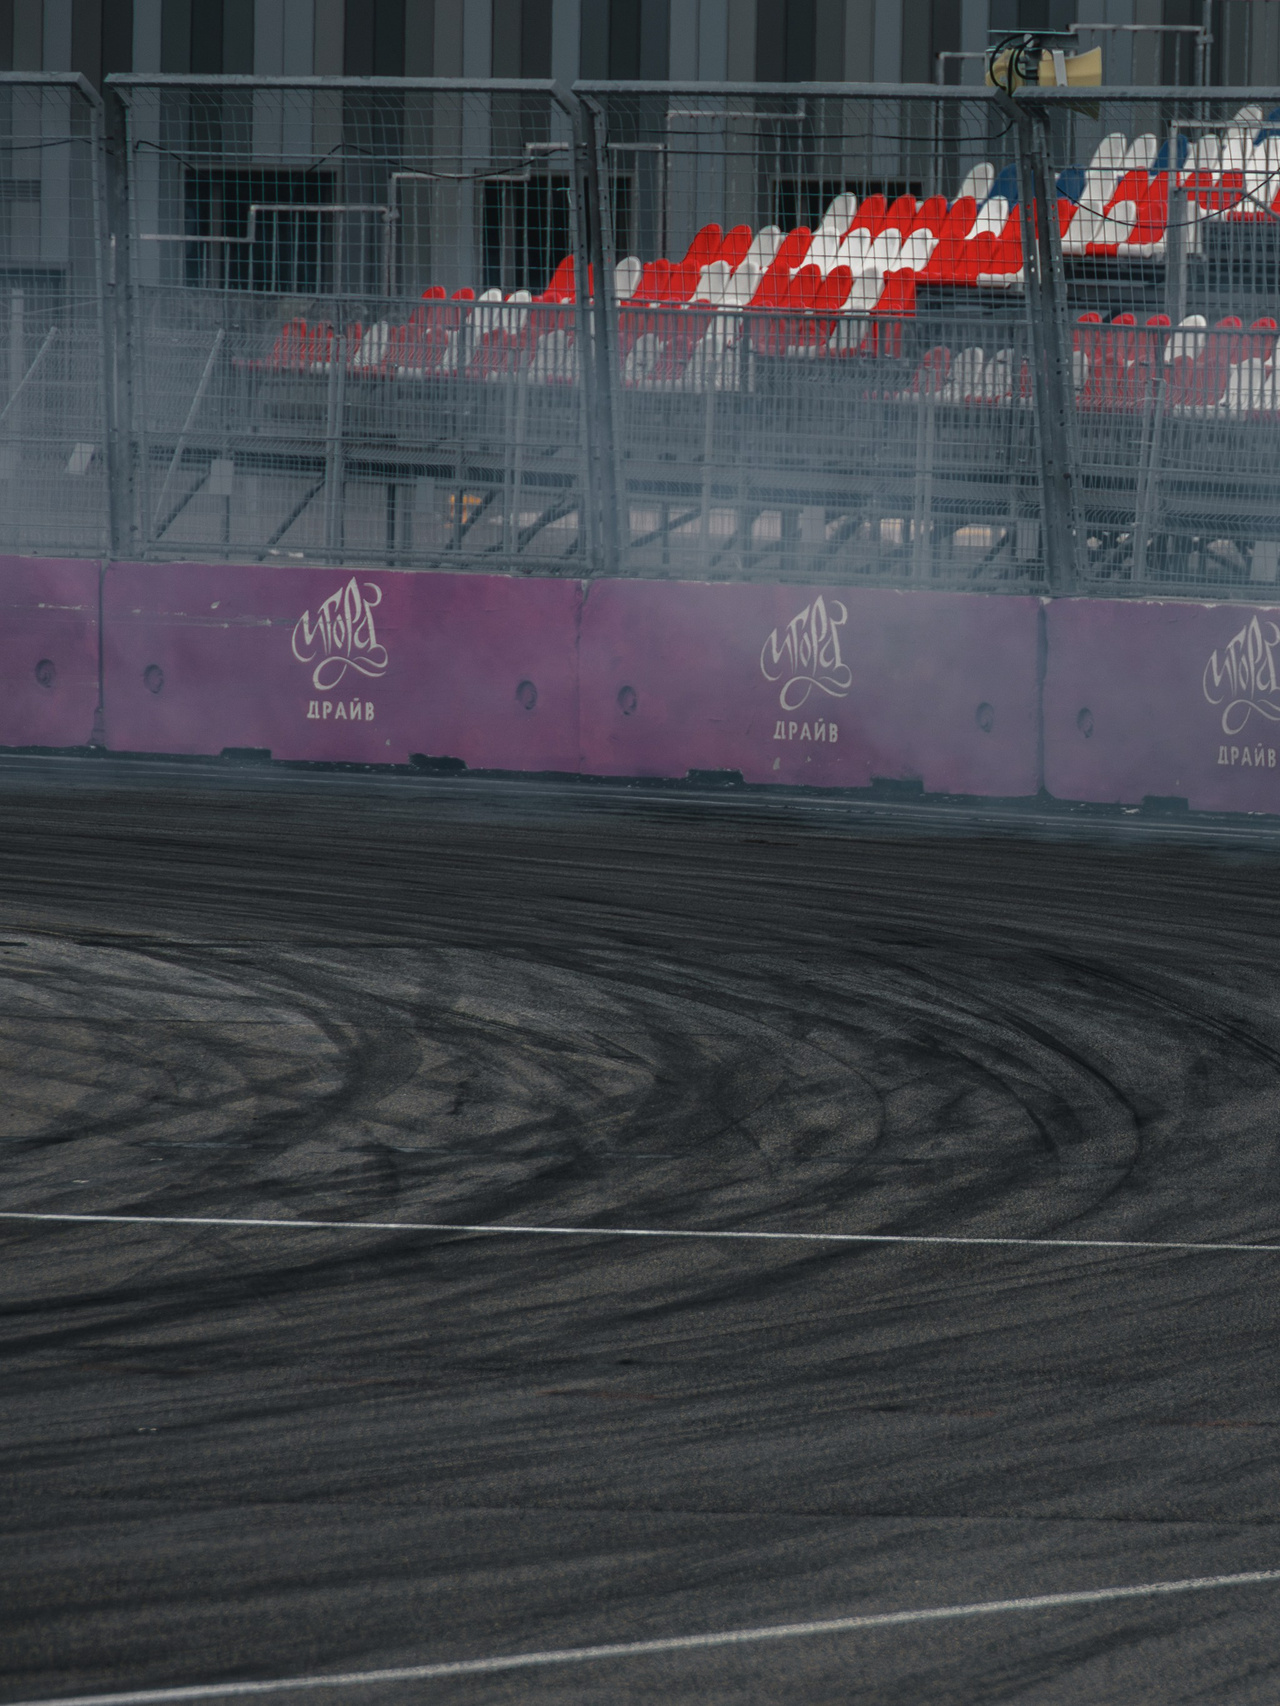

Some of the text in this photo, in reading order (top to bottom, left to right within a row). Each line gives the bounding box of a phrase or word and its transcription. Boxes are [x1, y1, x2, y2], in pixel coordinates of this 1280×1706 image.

[306, 697, 375, 721] ДРАЙВ
[773, 718, 839, 743] ДРАЙВ
[1217, 742, 1277, 768] ДРАЙВ
